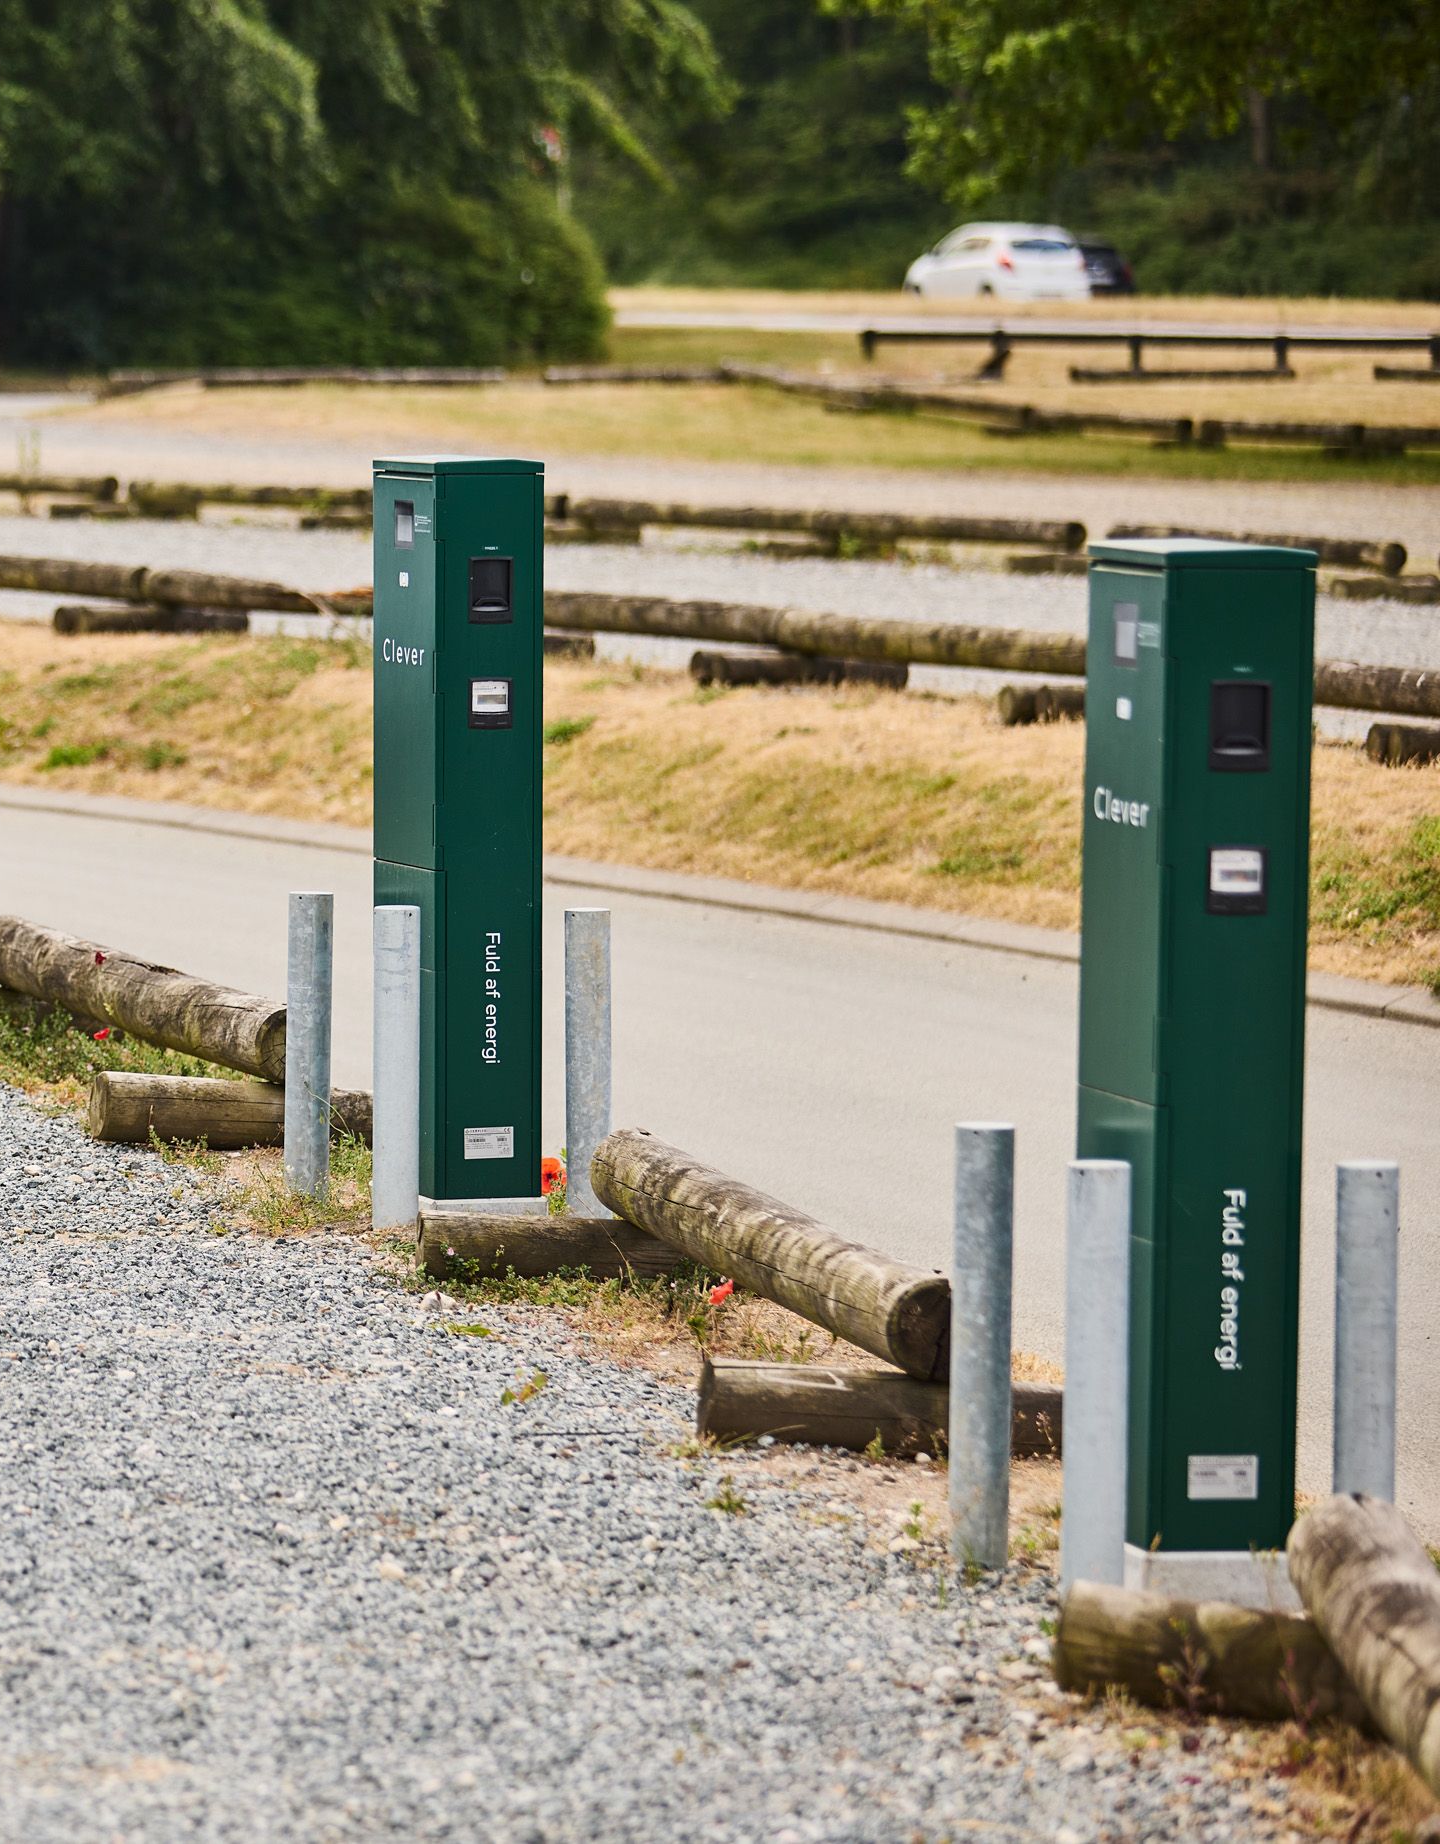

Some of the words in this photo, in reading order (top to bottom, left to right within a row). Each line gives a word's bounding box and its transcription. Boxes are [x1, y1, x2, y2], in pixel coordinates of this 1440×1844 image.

[383, 638, 424, 666] Clever
[1093, 786, 1150, 828] Clever
[485, 932, 500, 972] Fuld
[485, 979, 500, 998] af
[482, 1003, 500, 1064] energi
[1221, 1188, 1247, 1246] Fuld
[1221, 1252, 1245, 1282] af
[1214, 1286, 1243, 1371] energi
